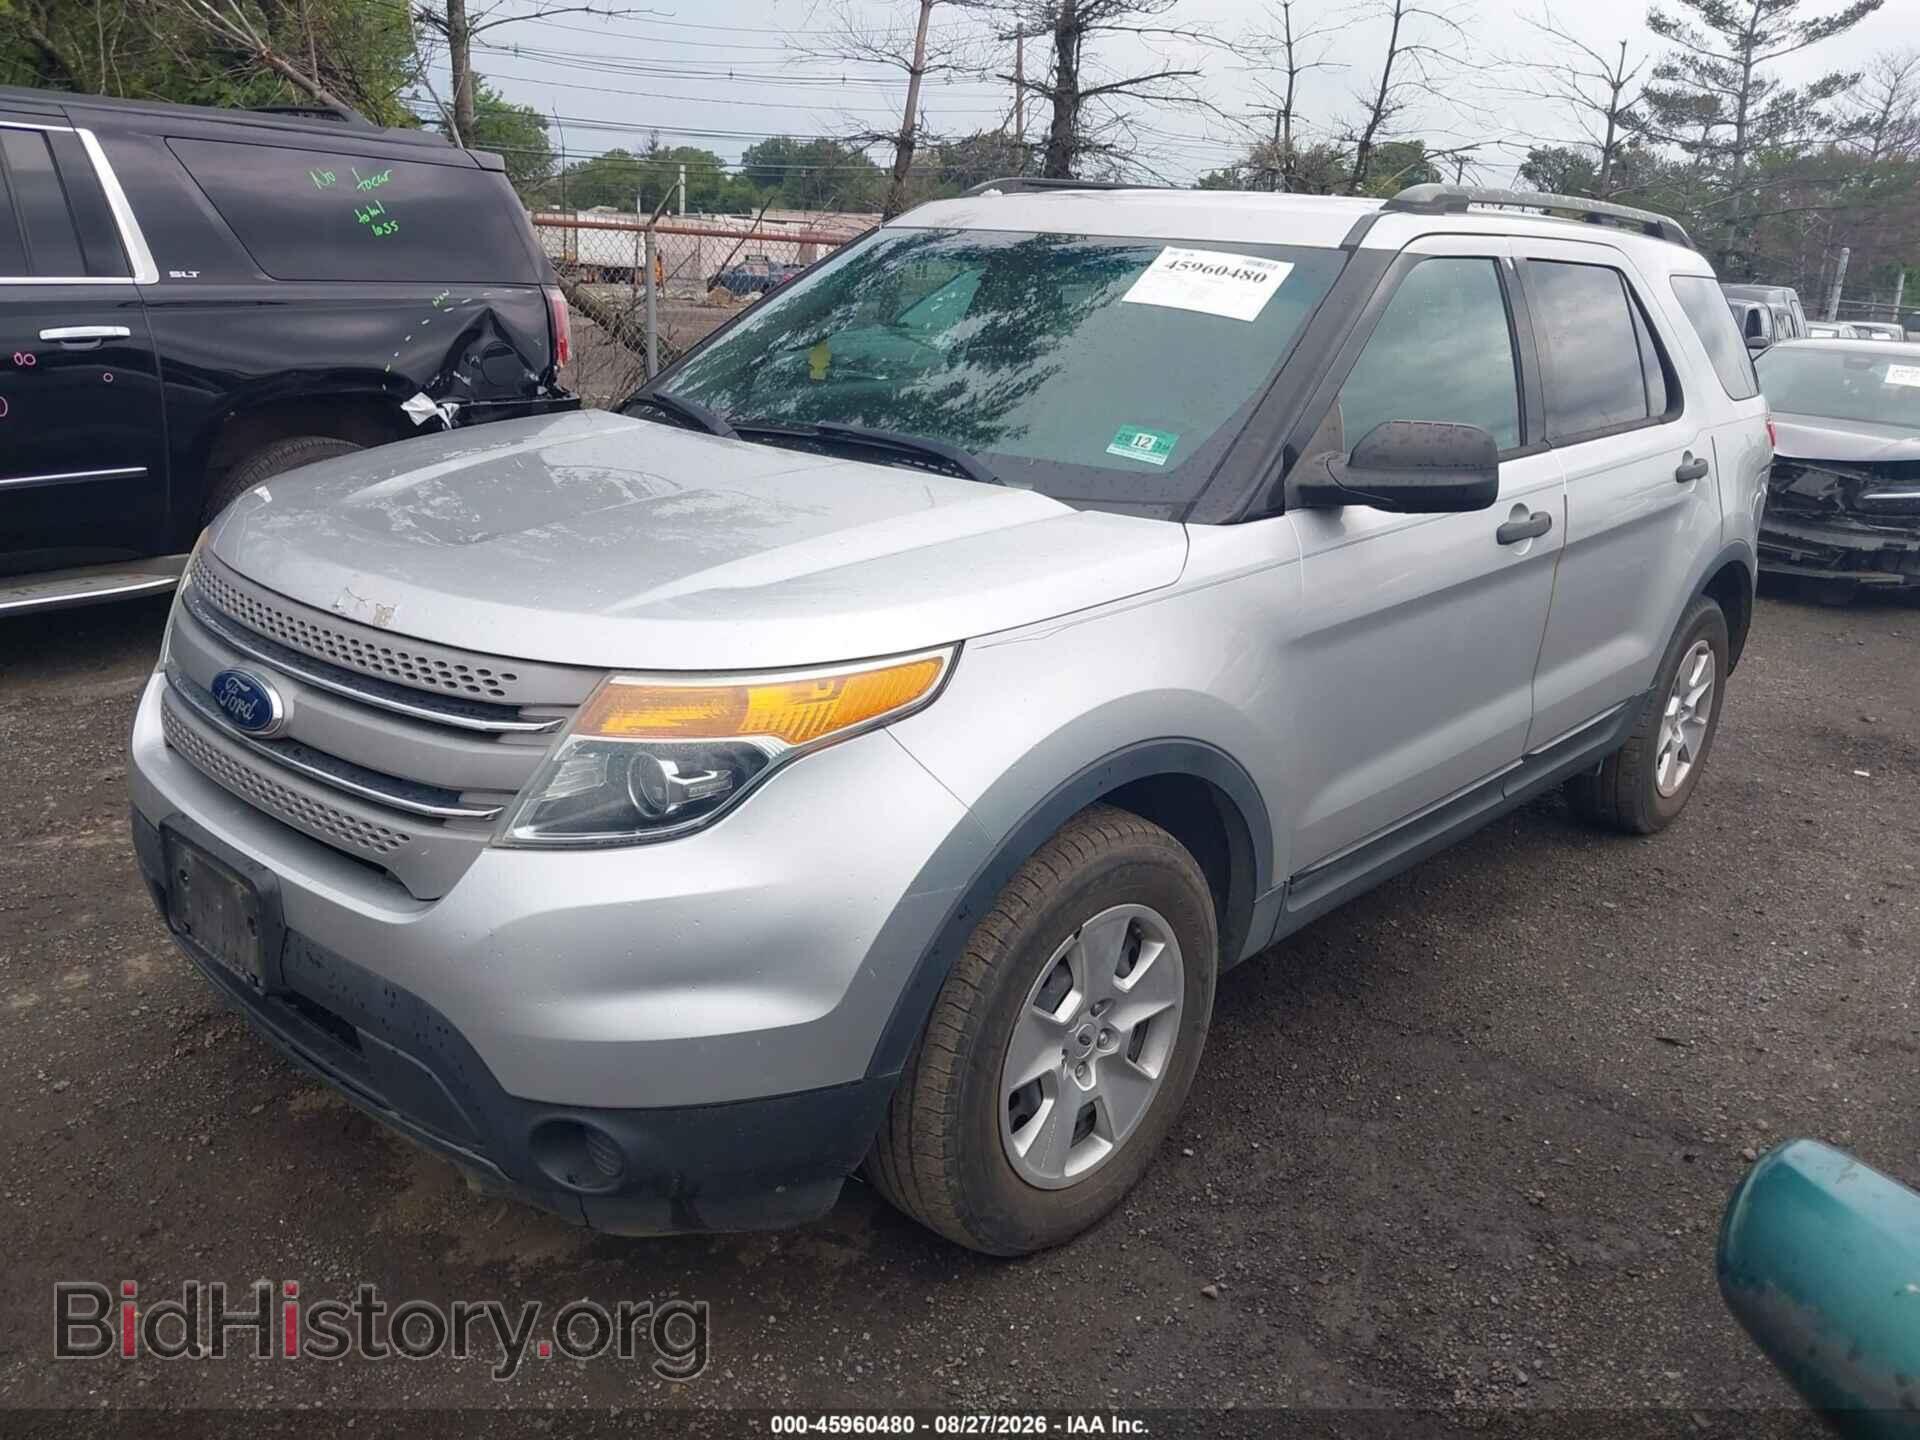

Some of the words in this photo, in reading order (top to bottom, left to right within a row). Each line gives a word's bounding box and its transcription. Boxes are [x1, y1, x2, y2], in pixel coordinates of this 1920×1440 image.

[169, 270, 200, 278] SLT
[1165, 260, 1267, 284] 45960480
[1134, 434, 1153, 449] 12
[216, 676, 259, 720] Ford
